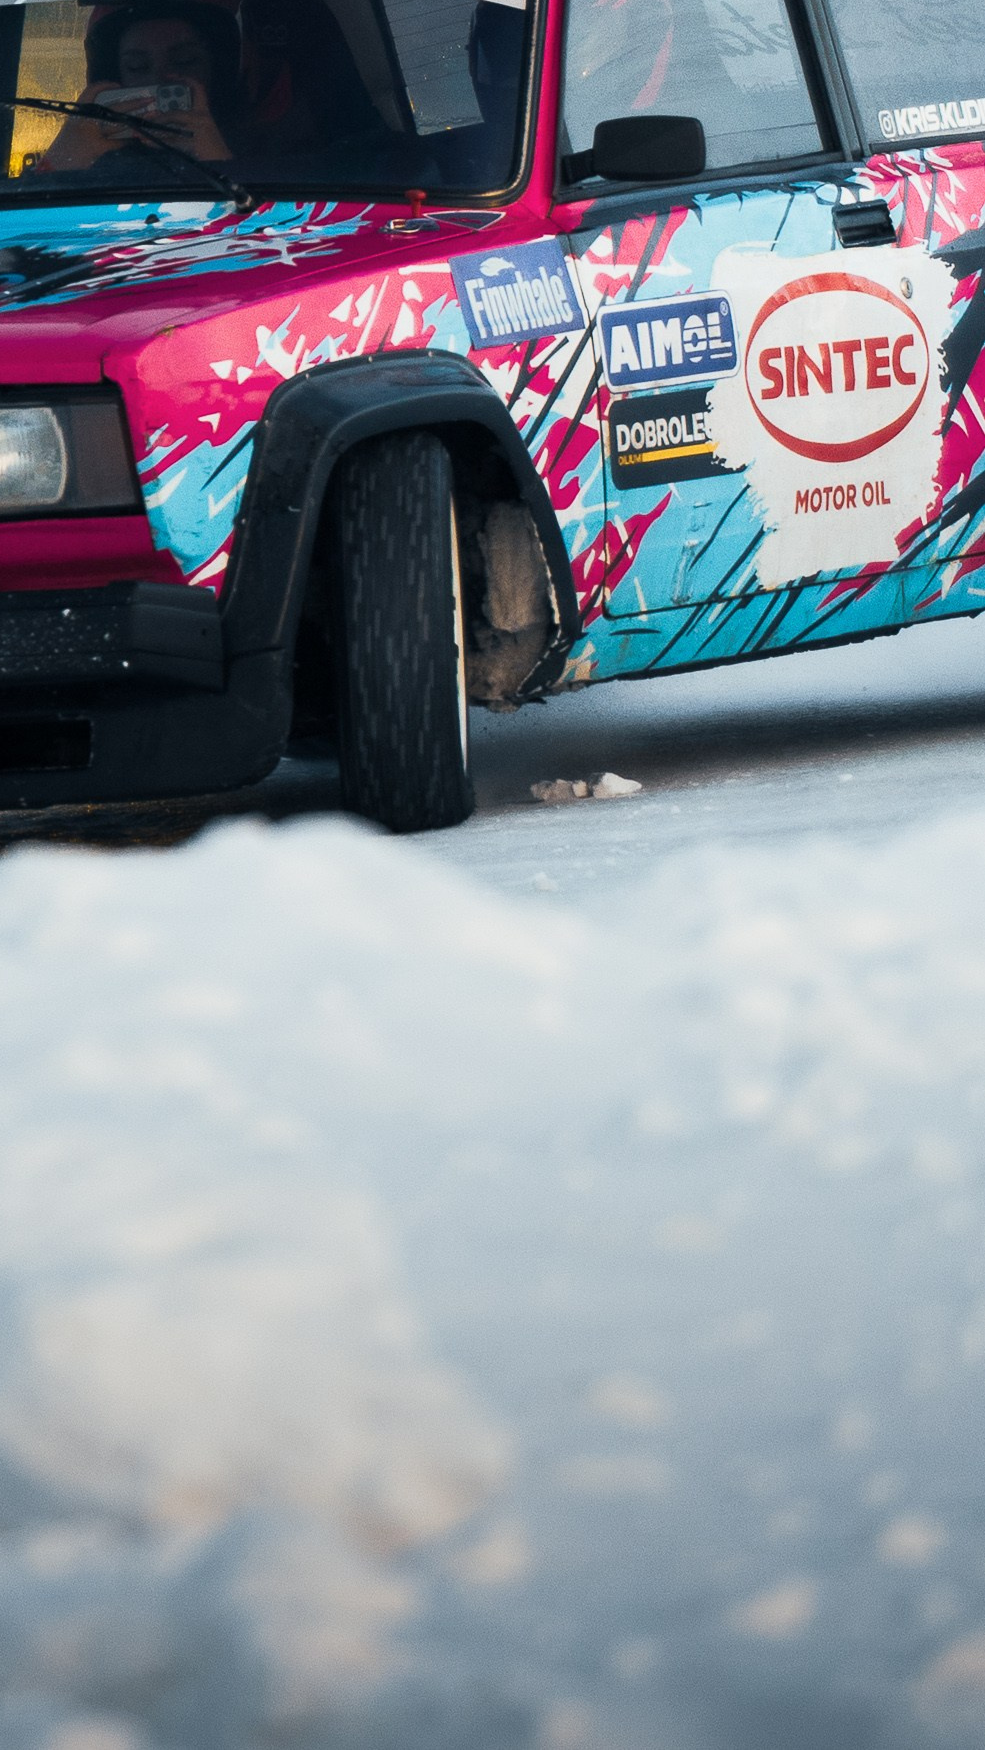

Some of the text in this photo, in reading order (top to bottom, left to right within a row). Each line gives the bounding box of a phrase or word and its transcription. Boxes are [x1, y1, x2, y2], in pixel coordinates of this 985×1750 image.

[464, 266, 574, 339] Finwhale
[610, 311, 733, 374] AIMOL
[759, 334, 916, 400] SINTEC
[795, 481, 891, 514] MOTOR OIL
